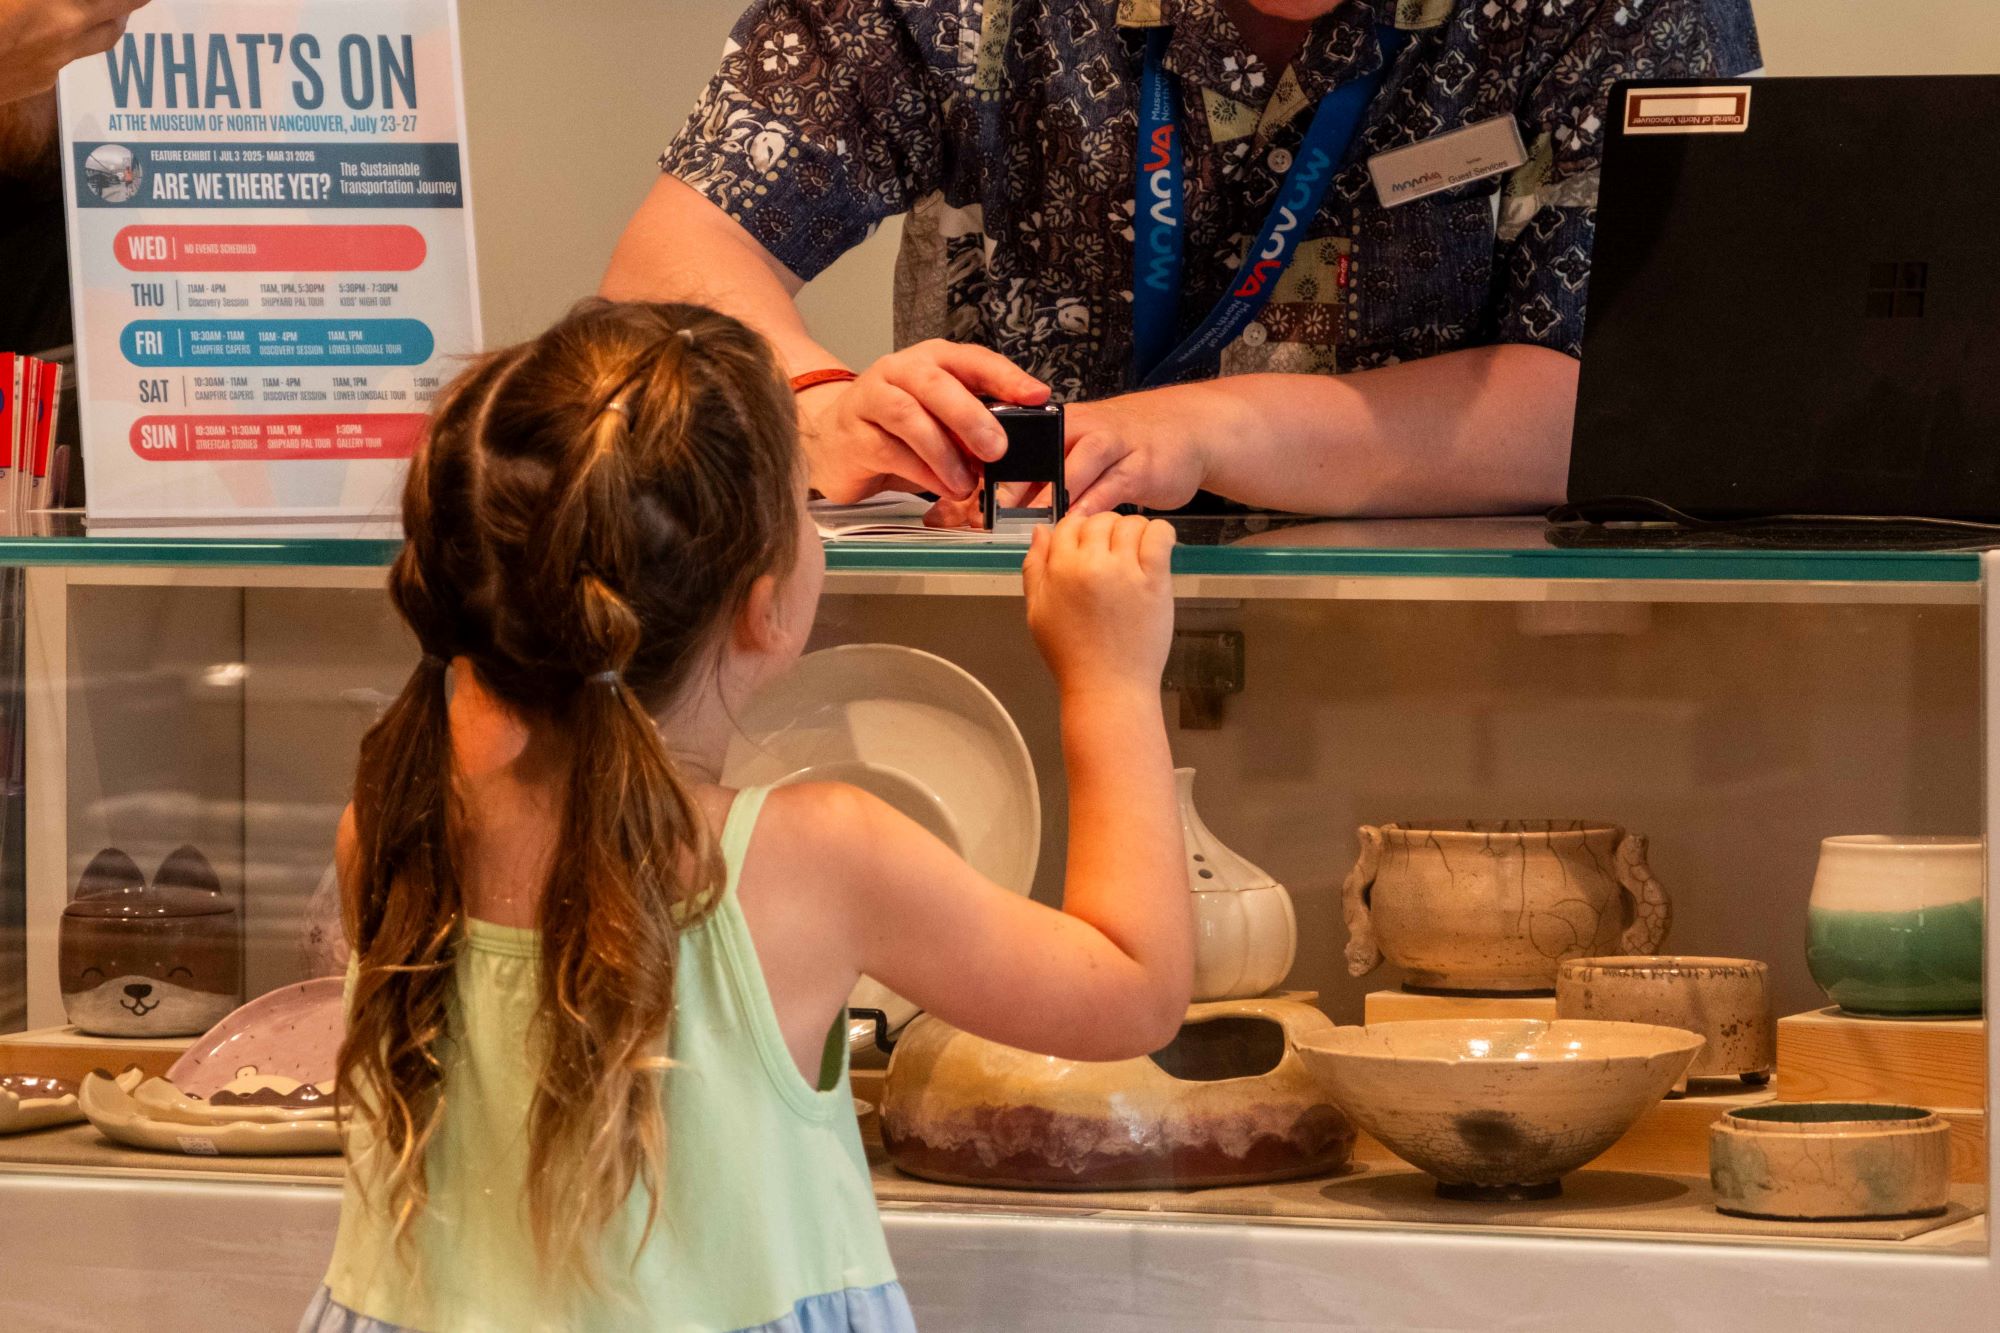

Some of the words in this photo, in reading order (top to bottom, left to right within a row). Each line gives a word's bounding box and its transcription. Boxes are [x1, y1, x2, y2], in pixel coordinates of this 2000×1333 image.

[105, 32, 324, 110] WHAT'S
[338, 33, 417, 110] ON
[1151, 73, 1161, 121] Museum
[1161, 88, 1170, 121] North
[109, 114, 122, 131] AT
[124, 114, 147, 131] THE
[150, 114, 206, 132] MUSEUM
[209, 114, 224, 132] OF
[227, 114, 267, 132] NORTH
[270, 115, 348, 134] VANCOUVER,
[350, 115, 377, 134] July
[1702, 116, 1711, 124] of
[1712, 115, 1741, 125] District
[151, 150, 182, 161] FEATURE
[183, 150, 212, 161] EXHIBIT
[219, 151, 233, 162] JUL
[234, 151, 240, 162] 3
[267, 151, 285, 161] MAR
[285, 151, 294, 162] 31
[294, 151, 315, 162] 2026
[340, 162, 358, 176] The
[360, 162, 420, 177] Sustainable
[1448, 172, 1473, 184] Guest
[1473, 160, 1508, 176] Services
[152, 172, 190, 200] ARE
[193, 172, 223, 200] WE
[225, 172, 285, 200] THERE
[287, 172, 332, 200] YET?
[340, 180, 414, 195] Transportation
[417, 180, 457, 196] Journey
[128, 236, 167, 260] WED
[184, 244, 195, 254] NO
[195, 244, 219, 254] EVENTS
[220, 244, 256, 254] SCHEDULED
[188, 284, 204, 293] 11AM
[211, 284, 226, 293] 4PM
[298, 283, 325, 293] 5:30PM
[339, 283, 366, 293] 5:30PM
[372, 283, 398, 293] 7:30PM
[131, 283, 164, 307] THU
[188, 297, 221, 308] Discovery
[223, 297, 249, 307] Session
[261, 297, 292, 307] SHIPYARD
[294, 297, 306, 307] PAL
[308, 297, 324, 307] TOUR
[359, 297, 378, 307] NIGHT
[380, 297, 392, 307] OUT
[1216, 299, 1242, 326] North
[1218, 302, 1251, 338] Museum
[191, 331, 221, 341] 10:30AM
[227, 331, 245, 340] 11AM
[258, 332, 277, 341] 11AM
[282, 332, 298, 341] 4PM
[348, 331, 363, 340] 1PM
[135, 331, 163, 355] FRI
[1208, 338, 1219, 348] of
[191, 344, 224, 355] CAMPFIRE
[226, 344, 251, 355] CAPERS
[259, 345, 295, 355] DISCOVERY
[296, 345, 323, 355] SESSION
[328, 344, 351, 354] LOWER
[352, 344, 383, 354] LONSDALE
[385, 344, 402, 354] TOUR
[194, 377, 224, 387] 10:30AM
[230, 377, 248, 386] 11AM
[262, 378, 279, 387] 11AM
[286, 378, 301, 387] 4PM
[353, 377, 367, 386] 1PM
[139, 379, 169, 403] SAT
[195, 391, 227, 401] CAMPFIRE
[229, 391, 254, 401] CAPERS
[263, 391, 298, 401] DISCOVERY
[300, 391, 327, 401] SESSION
[333, 391, 356, 401] LOWER
[358, 391, 388, 400] LONSDALE
[390, 391, 406, 400] TOUR
[231, 426, 261, 435] 11:30AM
[287, 425, 302, 435] 1PM
[141, 424, 177, 449] SUN
[231, 439, 258, 449] STORIES
[267, 438, 299, 449] SHIPYARD
[301, 438, 313, 448] PAL
[314, 438, 331, 448] TOUR
[337, 438, 363, 448] GALLERY
[365, 438, 382, 448] TOUR
